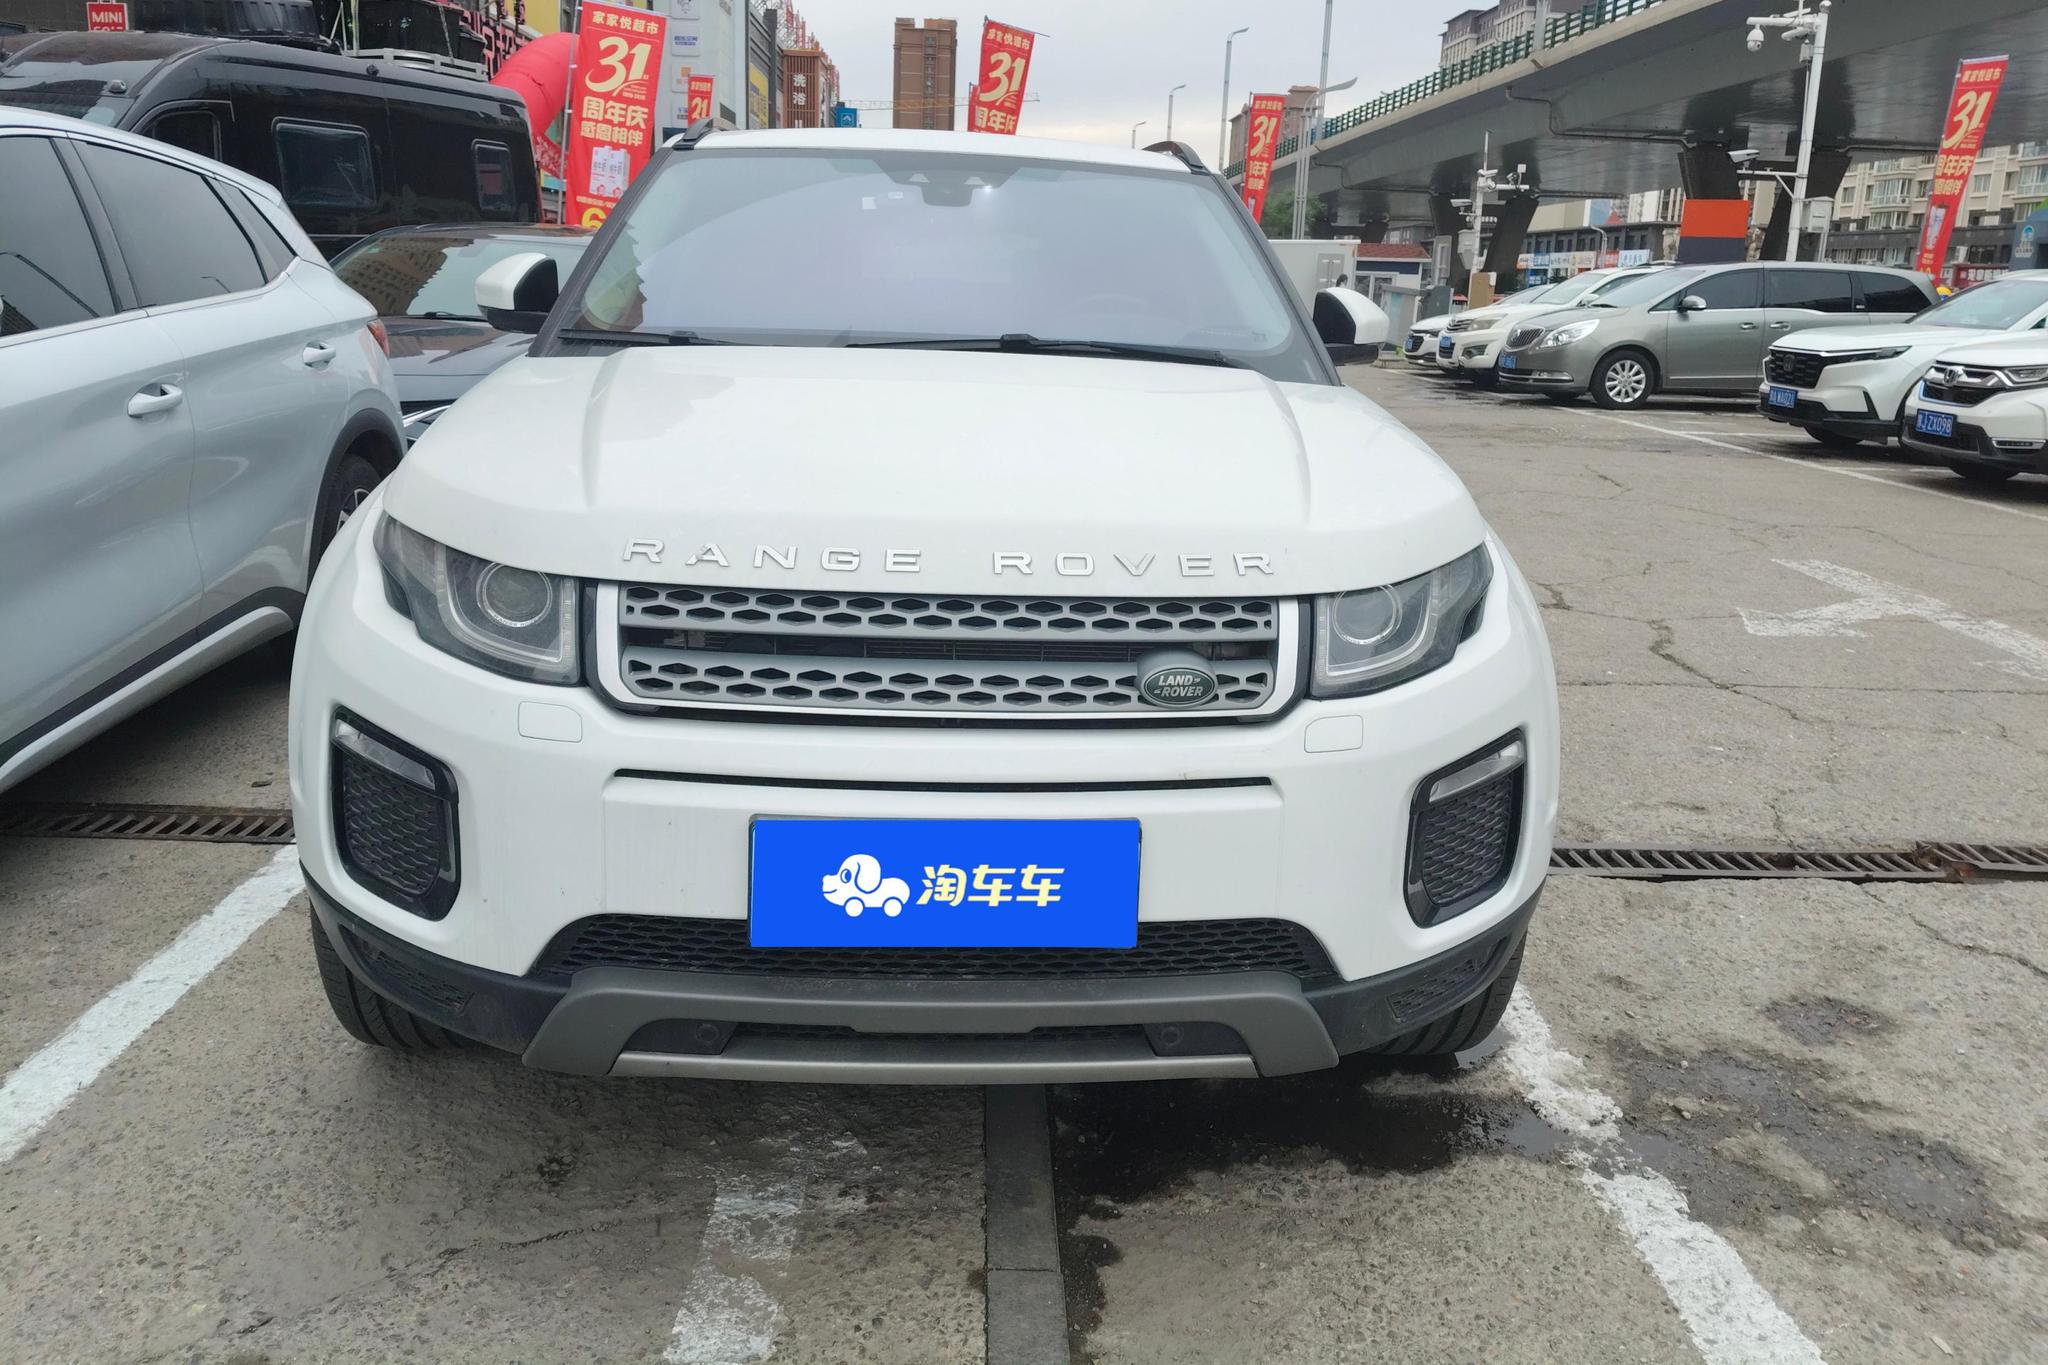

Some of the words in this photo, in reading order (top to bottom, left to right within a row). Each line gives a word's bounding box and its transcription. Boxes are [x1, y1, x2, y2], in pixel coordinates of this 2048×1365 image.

[92, 11, 123, 23] MINI
[592, 10, 660, 35] 家家悦超市
[585, 36, 652, 93] 31
[979, 51, 1026, 102] 31
[793, 73, 808, 106] 洗浴
[582, 96, 649, 129] 周年庆
[1943, 90, 1992, 149] 31
[1250, 115, 1278, 157] 31
[623, 538, 921, 573] RANGE
[993, 551, 1274, 576] ROVER
[1158, 675, 1194, 687] LAND
[1161, 686, 1204, 698] ROVER
